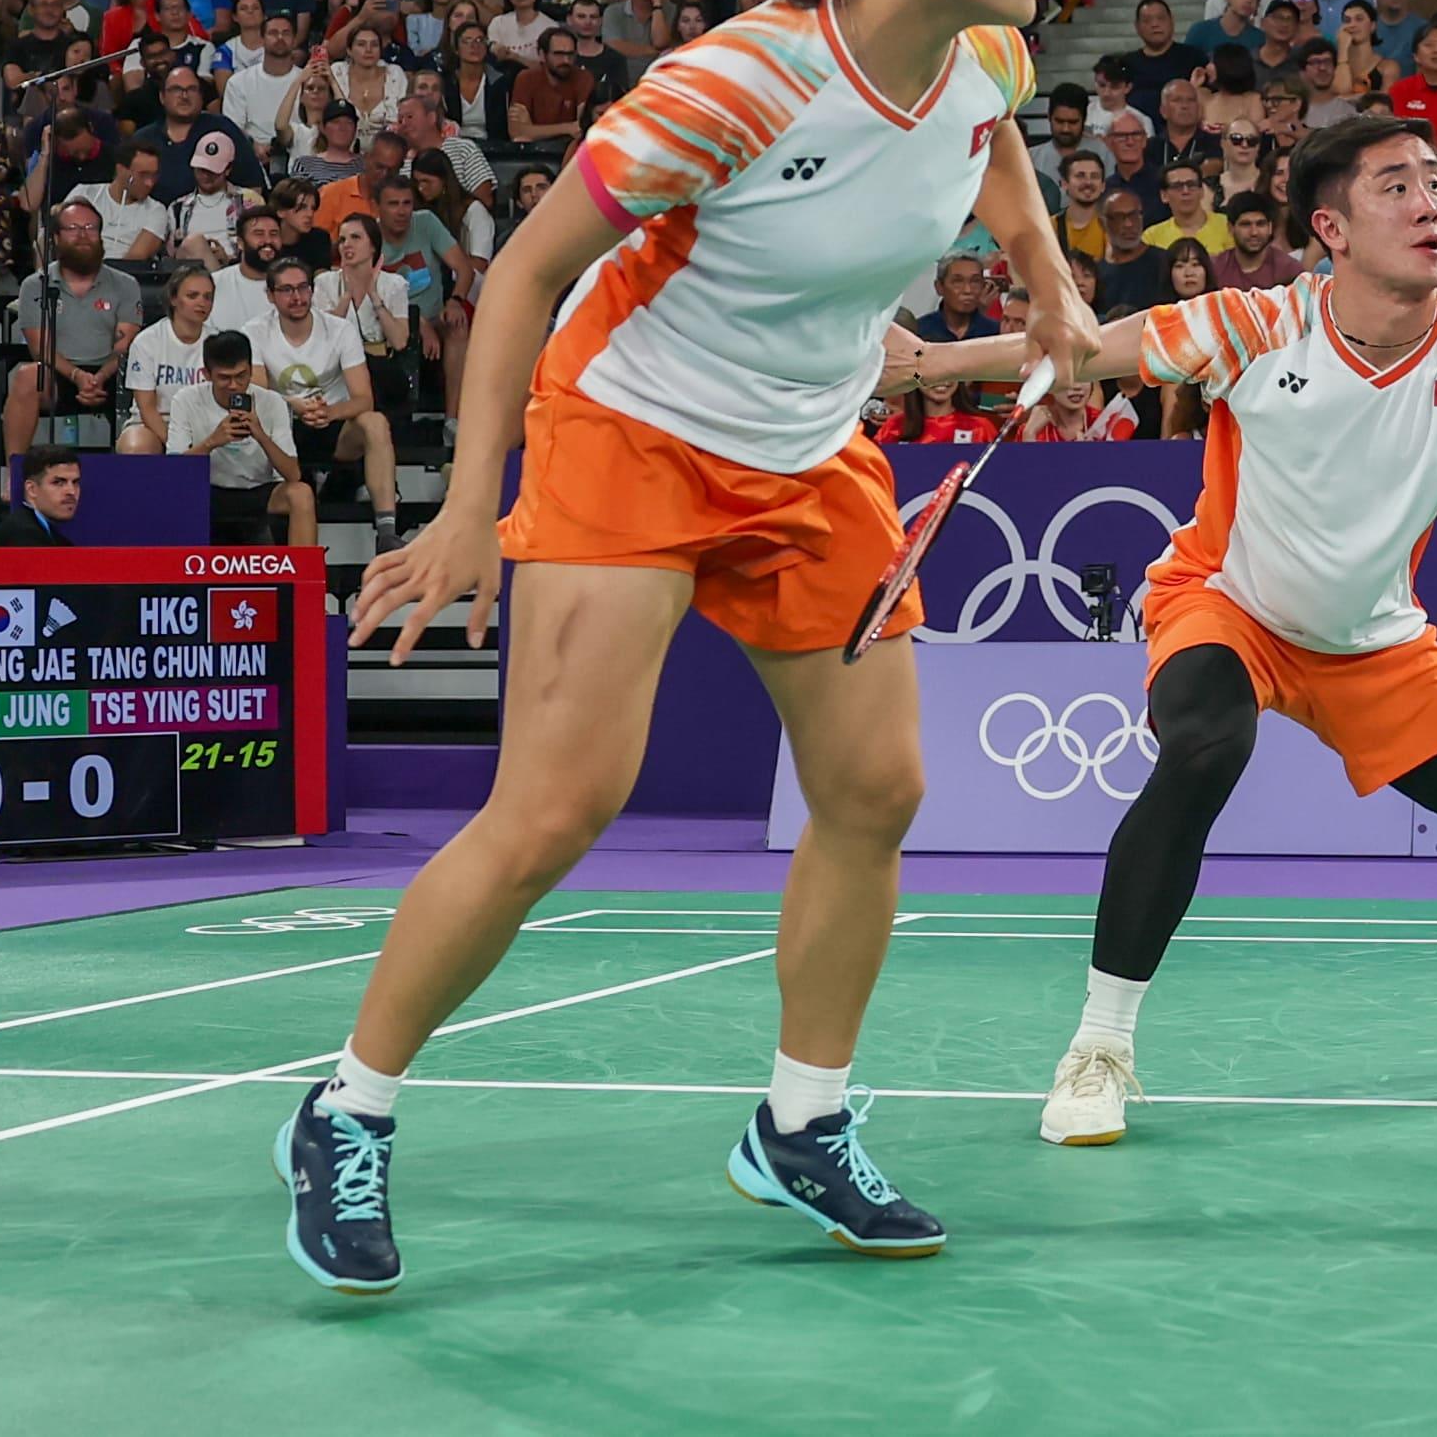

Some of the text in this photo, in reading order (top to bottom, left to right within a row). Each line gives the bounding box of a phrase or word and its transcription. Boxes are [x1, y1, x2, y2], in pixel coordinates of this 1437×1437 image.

[211, 554, 296, 575] OMEGA
[140, 596, 198, 635] HKG
[32, 648, 75, 681] JAE
[88, 644, 266, 679] TANG CHUN MAN
[3, 693, 70, 727] JUNG
[91, 688, 266, 725] TSE YING SUET
